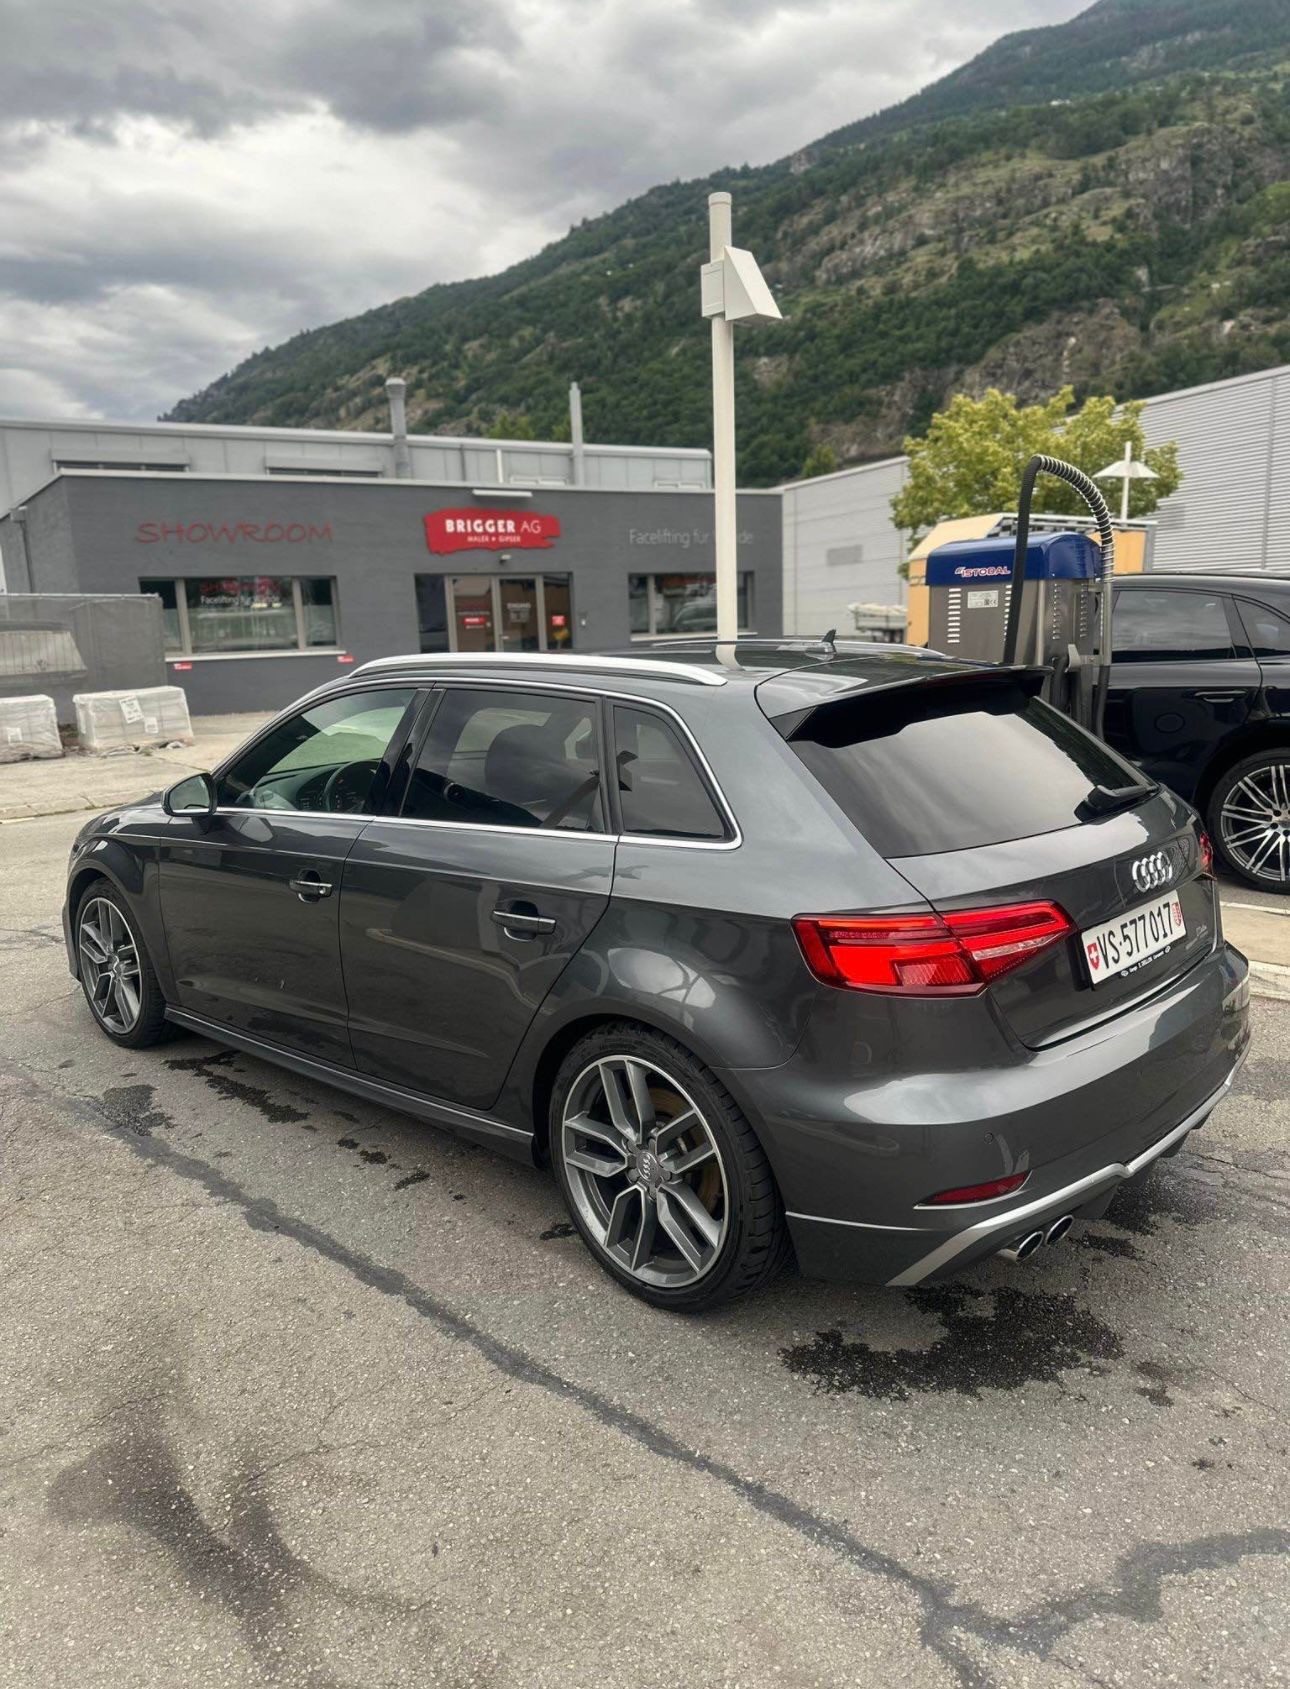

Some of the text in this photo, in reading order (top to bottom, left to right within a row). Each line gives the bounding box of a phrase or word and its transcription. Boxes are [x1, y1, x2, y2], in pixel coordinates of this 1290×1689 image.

[136, 522, 334, 544] SHOWROOM
[445, 519, 542, 533] BRIGGER AG
[629, 527, 690, 548] Facelifting
[693, 528, 709, 544] für
[962, 566, 1011, 577] ISTOBAL
